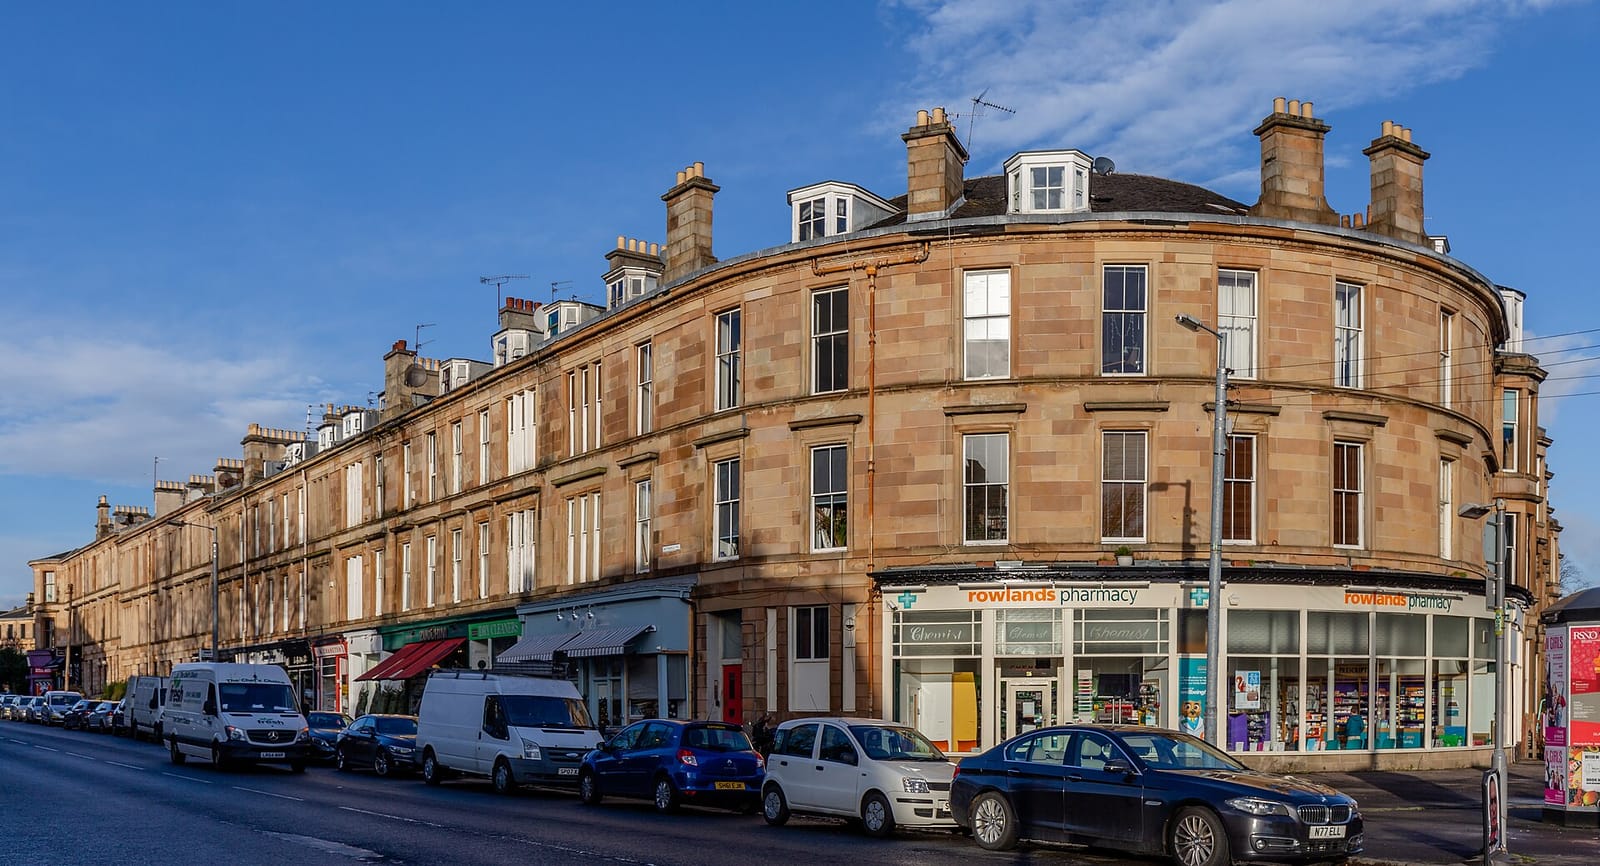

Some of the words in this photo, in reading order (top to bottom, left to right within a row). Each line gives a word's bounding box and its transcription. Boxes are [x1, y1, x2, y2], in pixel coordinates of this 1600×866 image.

[968, 587, 1056, 603] rowlands
[1060, 588, 1138, 605] pharmacy
[1344, 591, 1406, 606] rowlands
[1408, 594, 1452, 612] pharmacy
[911, 626, 962, 641] Chemist
[1090, 627, 1149, 640] Chemist
[1573, 631, 1598, 640] RSNO
[1550, 636, 1563, 650] GIRLS
[1550, 750, 1563, 763] GIRLS
[1314, 827, 1329, 837] N77
[1329, 826, 1341, 836] ELL
